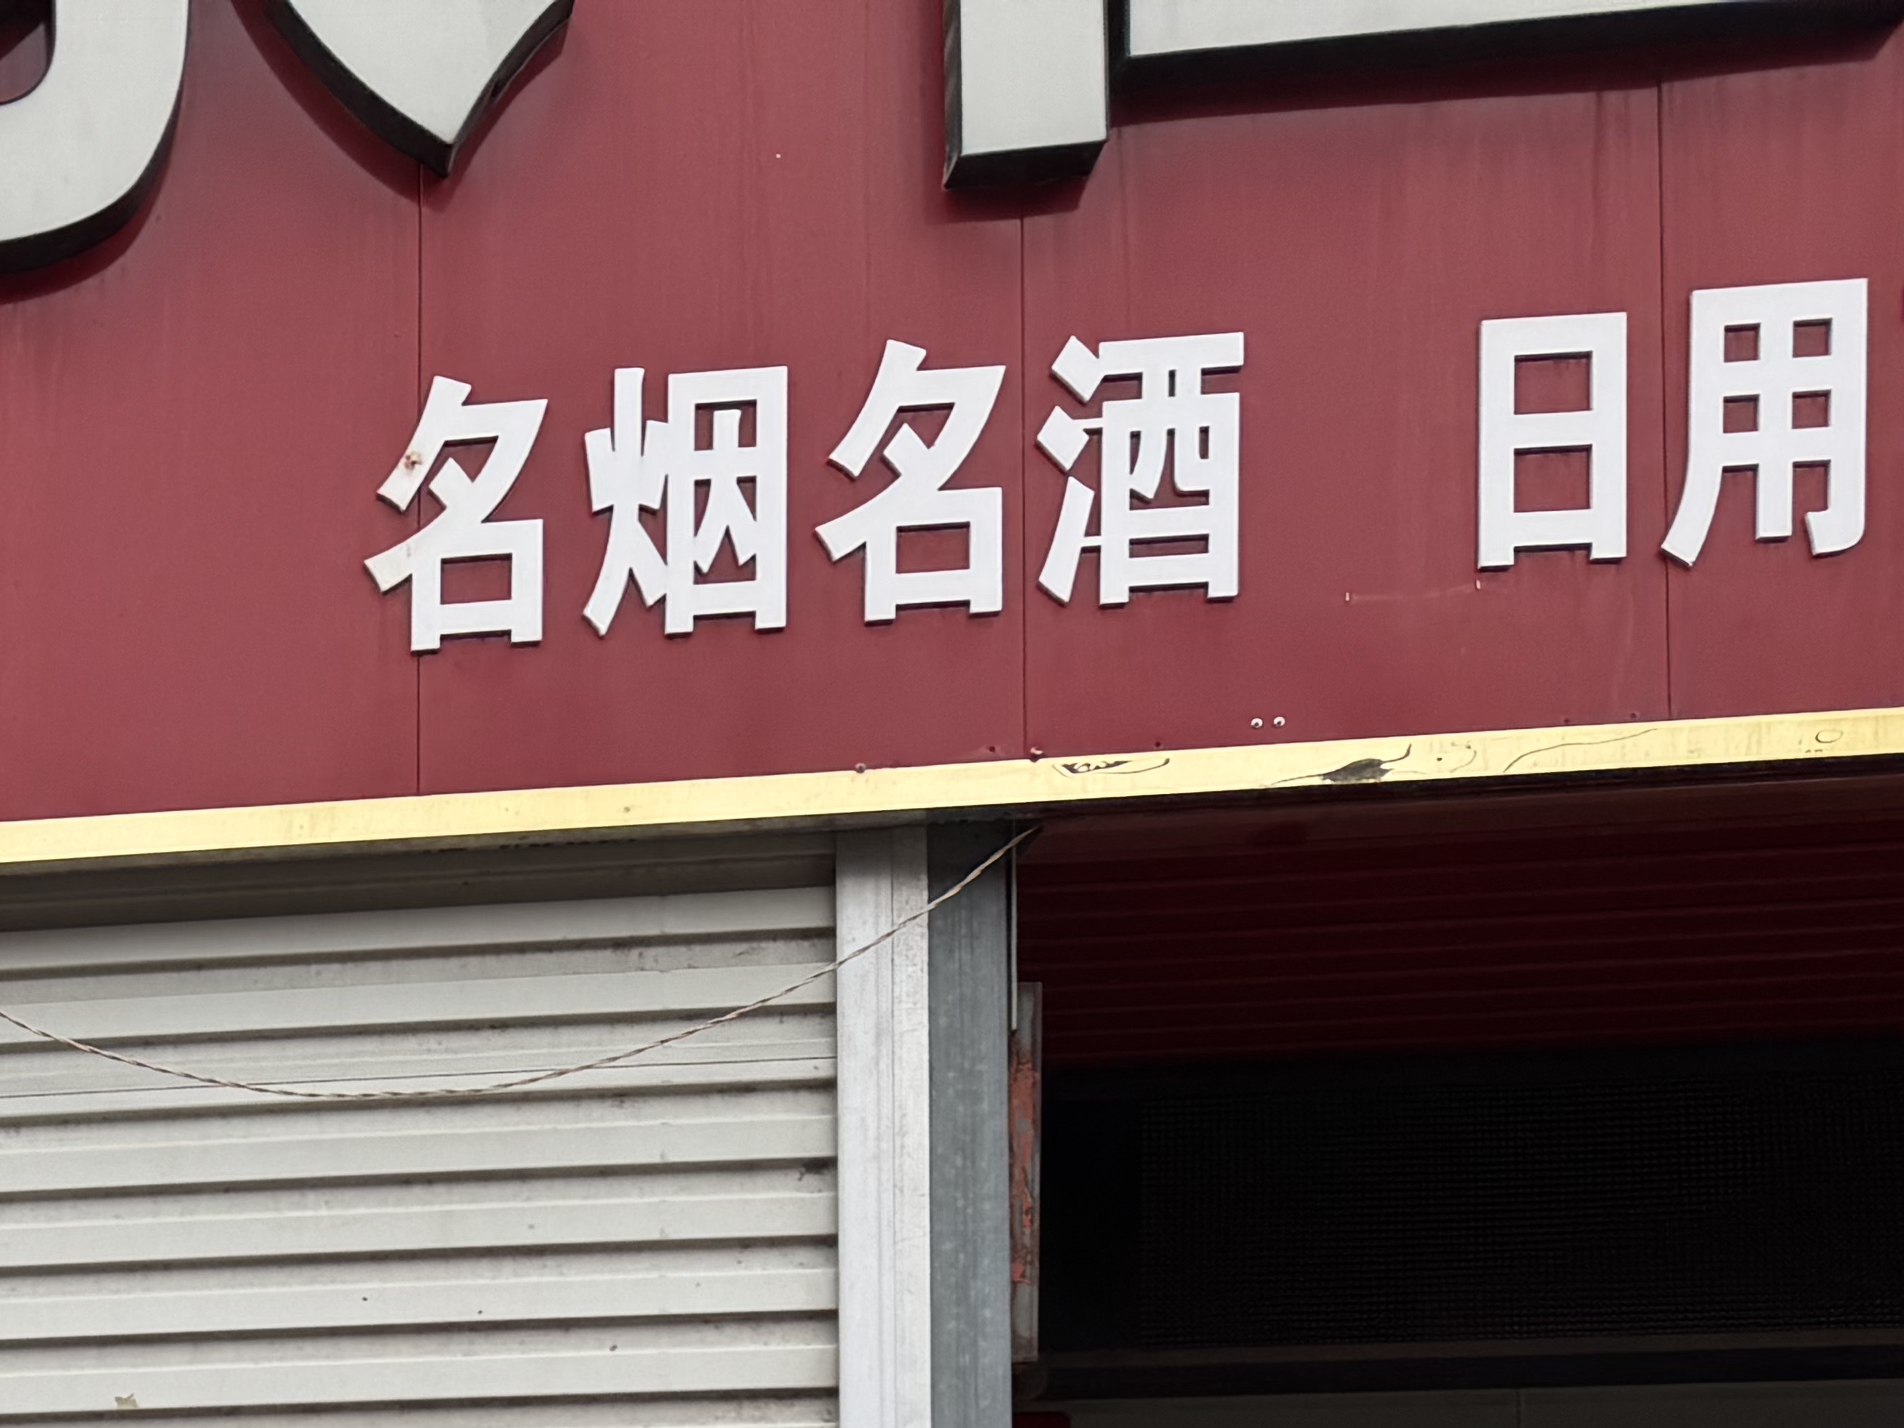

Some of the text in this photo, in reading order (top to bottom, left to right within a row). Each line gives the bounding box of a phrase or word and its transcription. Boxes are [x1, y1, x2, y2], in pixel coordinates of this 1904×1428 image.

[364, 277, 1869, 652] 名烟名酒 日用
